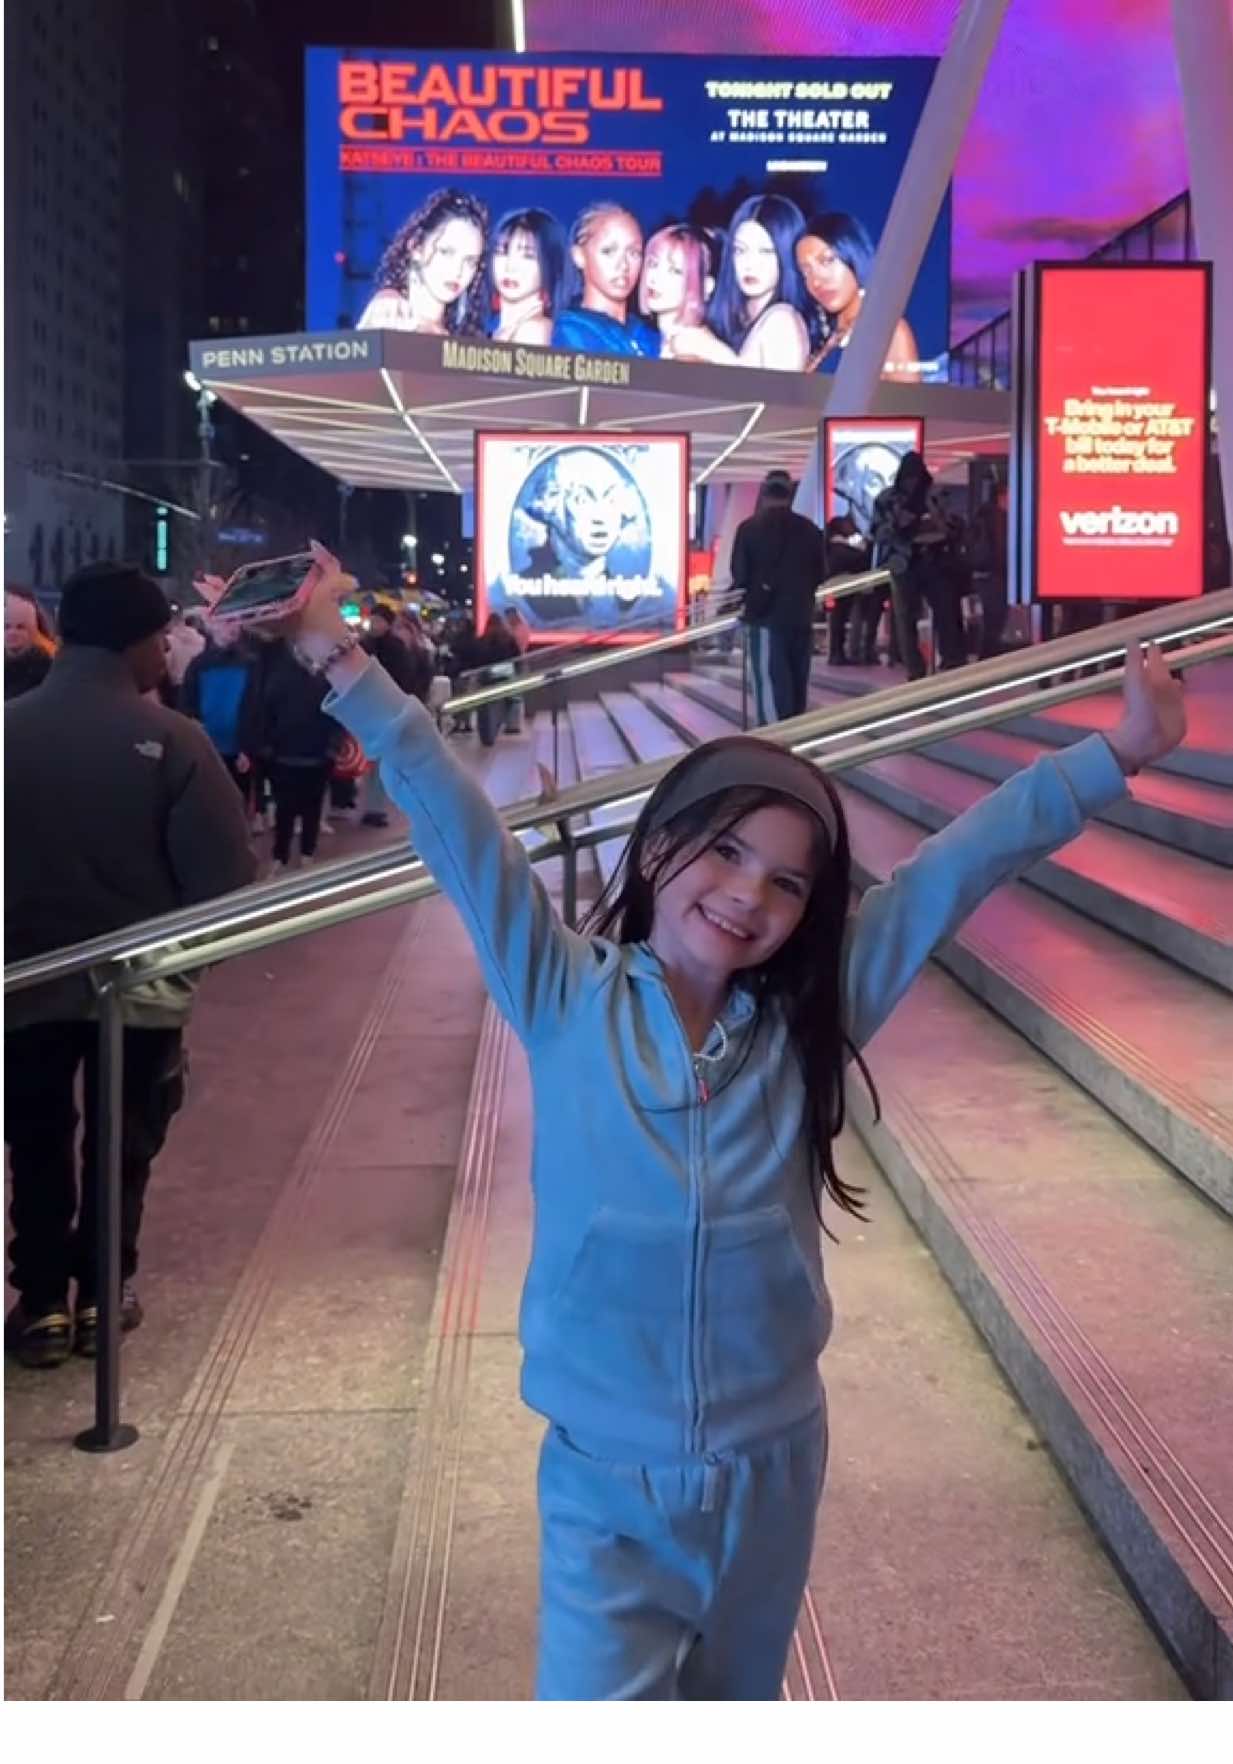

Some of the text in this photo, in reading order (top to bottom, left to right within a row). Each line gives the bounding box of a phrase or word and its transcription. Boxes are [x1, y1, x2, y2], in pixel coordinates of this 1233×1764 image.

[339, 61, 662, 110] BEAUTIFUL
[705, 81, 892, 99] TONIGHT SOLD OUT
[339, 106, 589, 144] CHAOS
[727, 109, 869, 128] THE THEATER
[710, 131, 887, 143] AT MADISON SQUARE GARDEN
[425, 151, 458, 169] THE
[460, 152, 549, 170] BEAUTIFUL
[553, 153, 613, 171] CHAOS
[615, 155, 662, 172] TOUR
[202, 340, 369, 369] PENN STATION
[1064, 399, 1174, 421] Bring in your
[1123, 422, 1143, 435] or
[1146, 418, 1194, 435] AT&T
[1094, 438, 1144, 457] today
[1064, 459, 1075, 472] a
[1077, 456, 1129, 472] better
[1060, 505, 1179, 535] verizon
